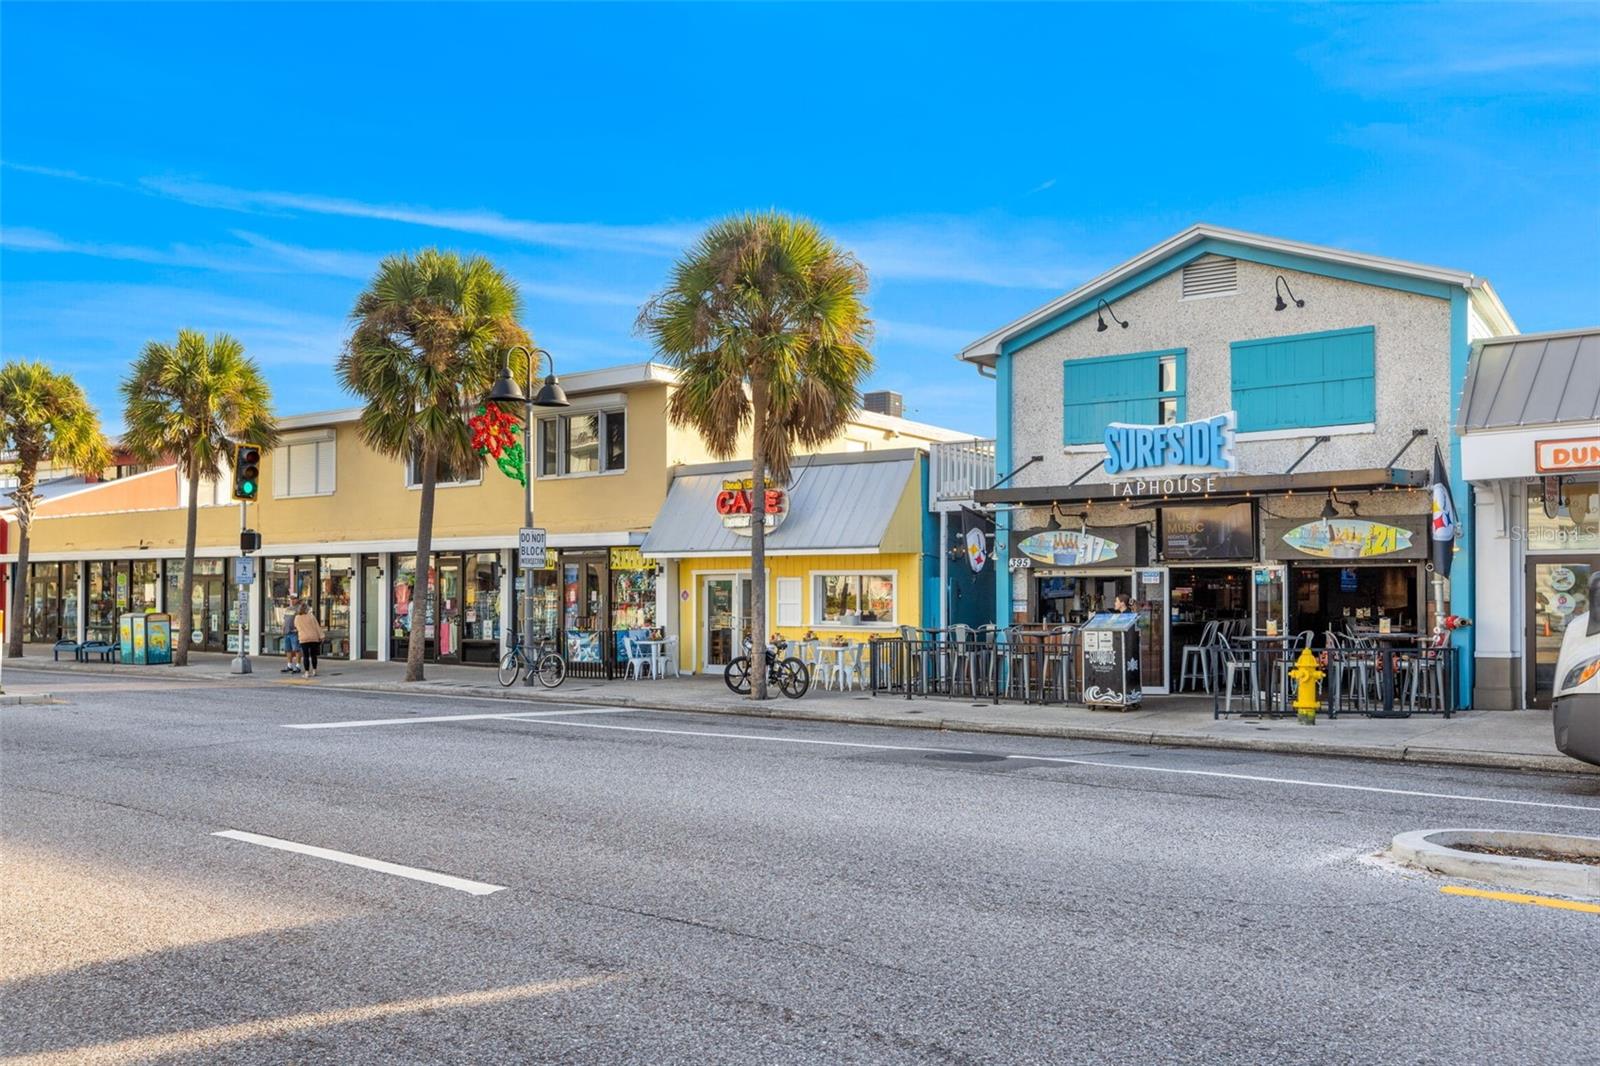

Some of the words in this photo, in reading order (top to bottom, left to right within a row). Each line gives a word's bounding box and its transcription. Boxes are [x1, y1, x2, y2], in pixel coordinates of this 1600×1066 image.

[1104, 414, 1229, 475] SURFSIDE
[1109, 477, 1217, 497] TAPHOUSE
[716, 489, 784, 515] CAE
[1167, 522, 1205, 534] MUSIC
[521, 533, 531, 543] DO
[532, 533, 545, 543] NOT
[521, 546, 545, 556] BLOCK
[1010, 558, 1028, 568] 395
